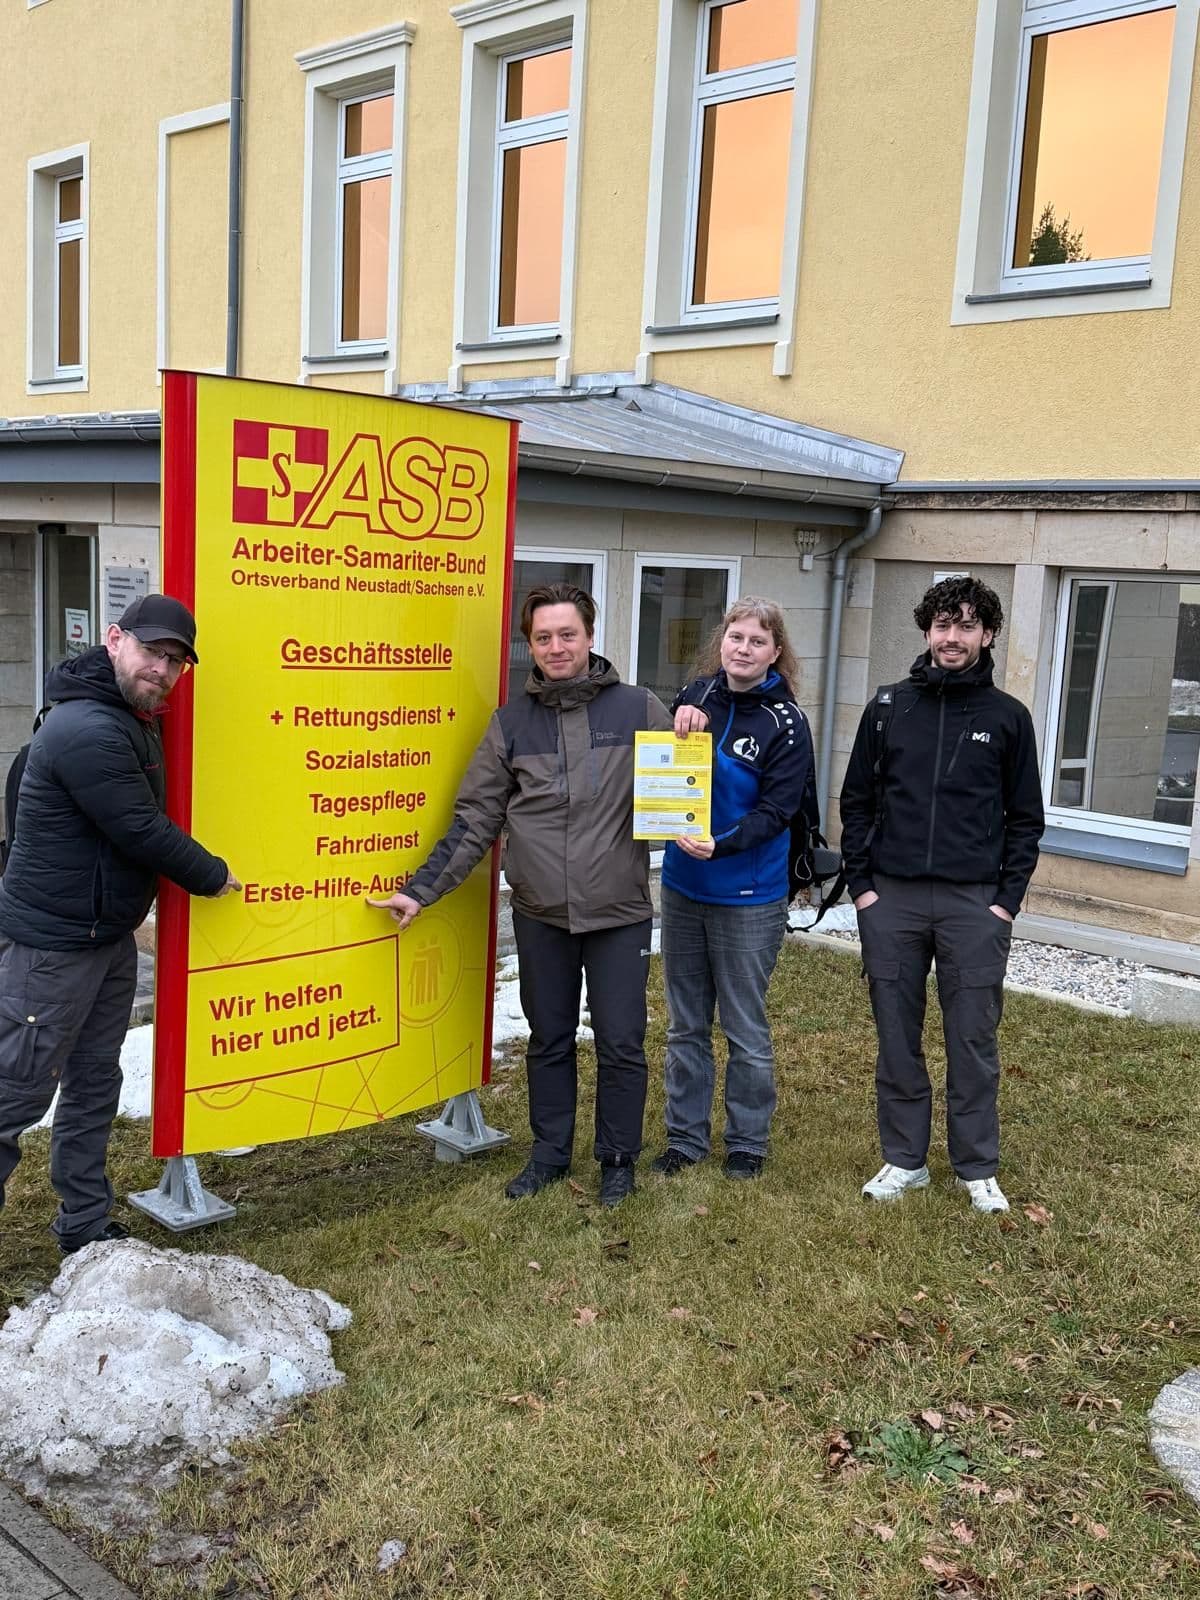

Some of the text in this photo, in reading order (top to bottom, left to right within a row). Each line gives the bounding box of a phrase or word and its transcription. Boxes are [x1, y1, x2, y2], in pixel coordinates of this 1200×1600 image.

[301, 432, 490, 541] ASB
[231, 536, 487, 576] Arbeiter-Samariter-Bund
[231, 569, 486, 598] Ortsverband Neustadt/Sachsen e.V.
[280, 638, 453, 666] Geschäftsstelle
[293, 705, 442, 732] Rettungsdienst
[305, 747, 431, 771] Sozialstation
[309, 789, 426, 818] Tagespflege
[316, 830, 419, 856] Fahrdienst
[209, 983, 342, 1021] Wir helfen
[211, 1004, 382, 1057] hier und jetzt.
